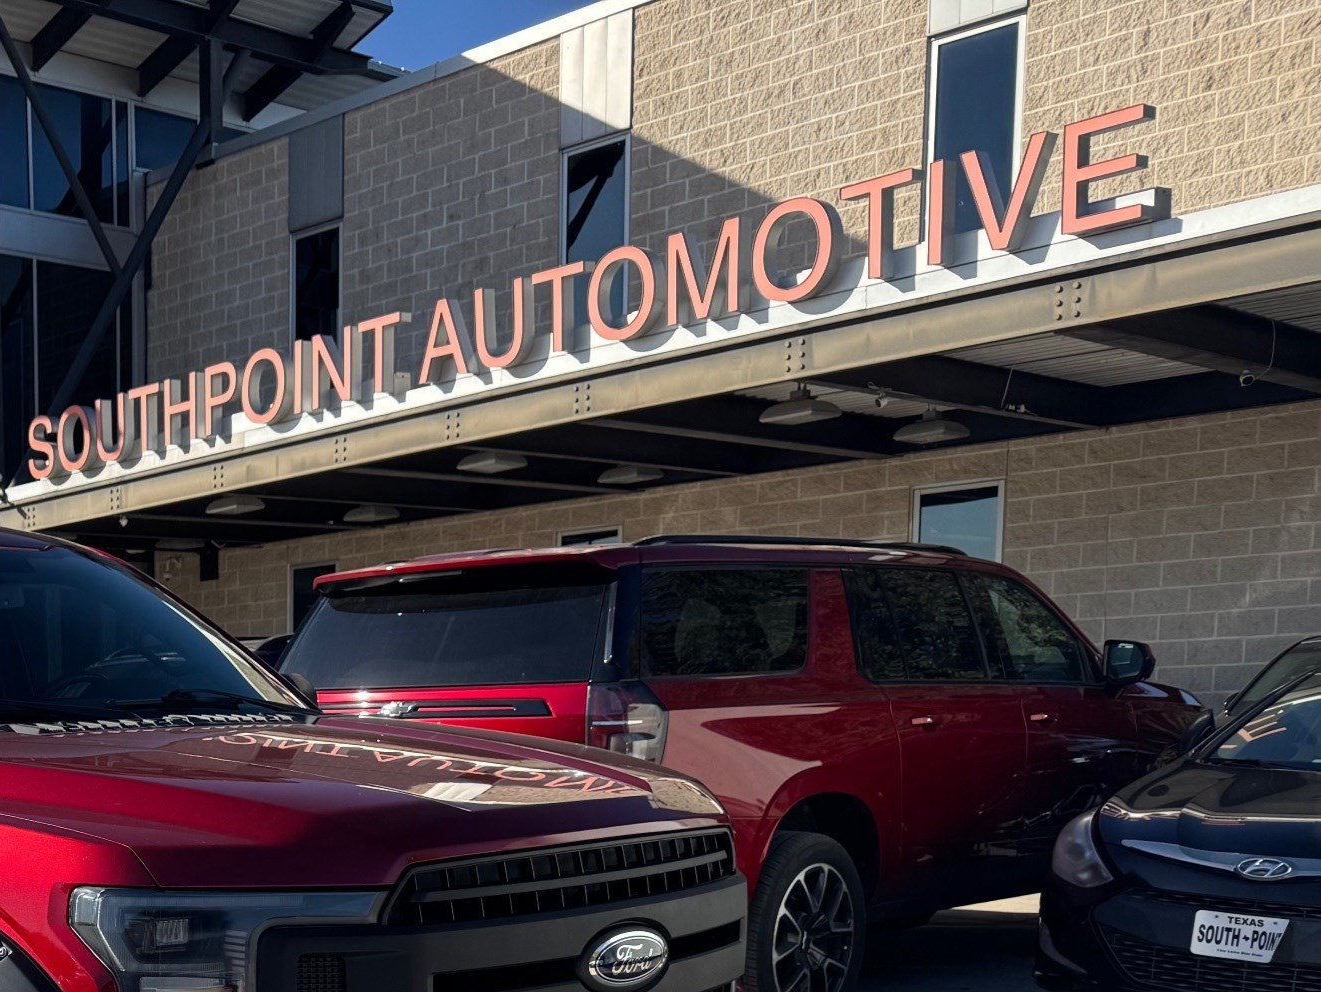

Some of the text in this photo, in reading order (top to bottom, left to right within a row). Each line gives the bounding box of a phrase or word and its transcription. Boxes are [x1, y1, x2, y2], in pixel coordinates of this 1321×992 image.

[28, 104, 1156, 481] SOUTHPOINT AUTOMOTIVE
[1197, 924, 1241, 947] SOUTH
[1227, 915, 1265, 928] TEXAS
[612, 943, 654, 976] Ford
